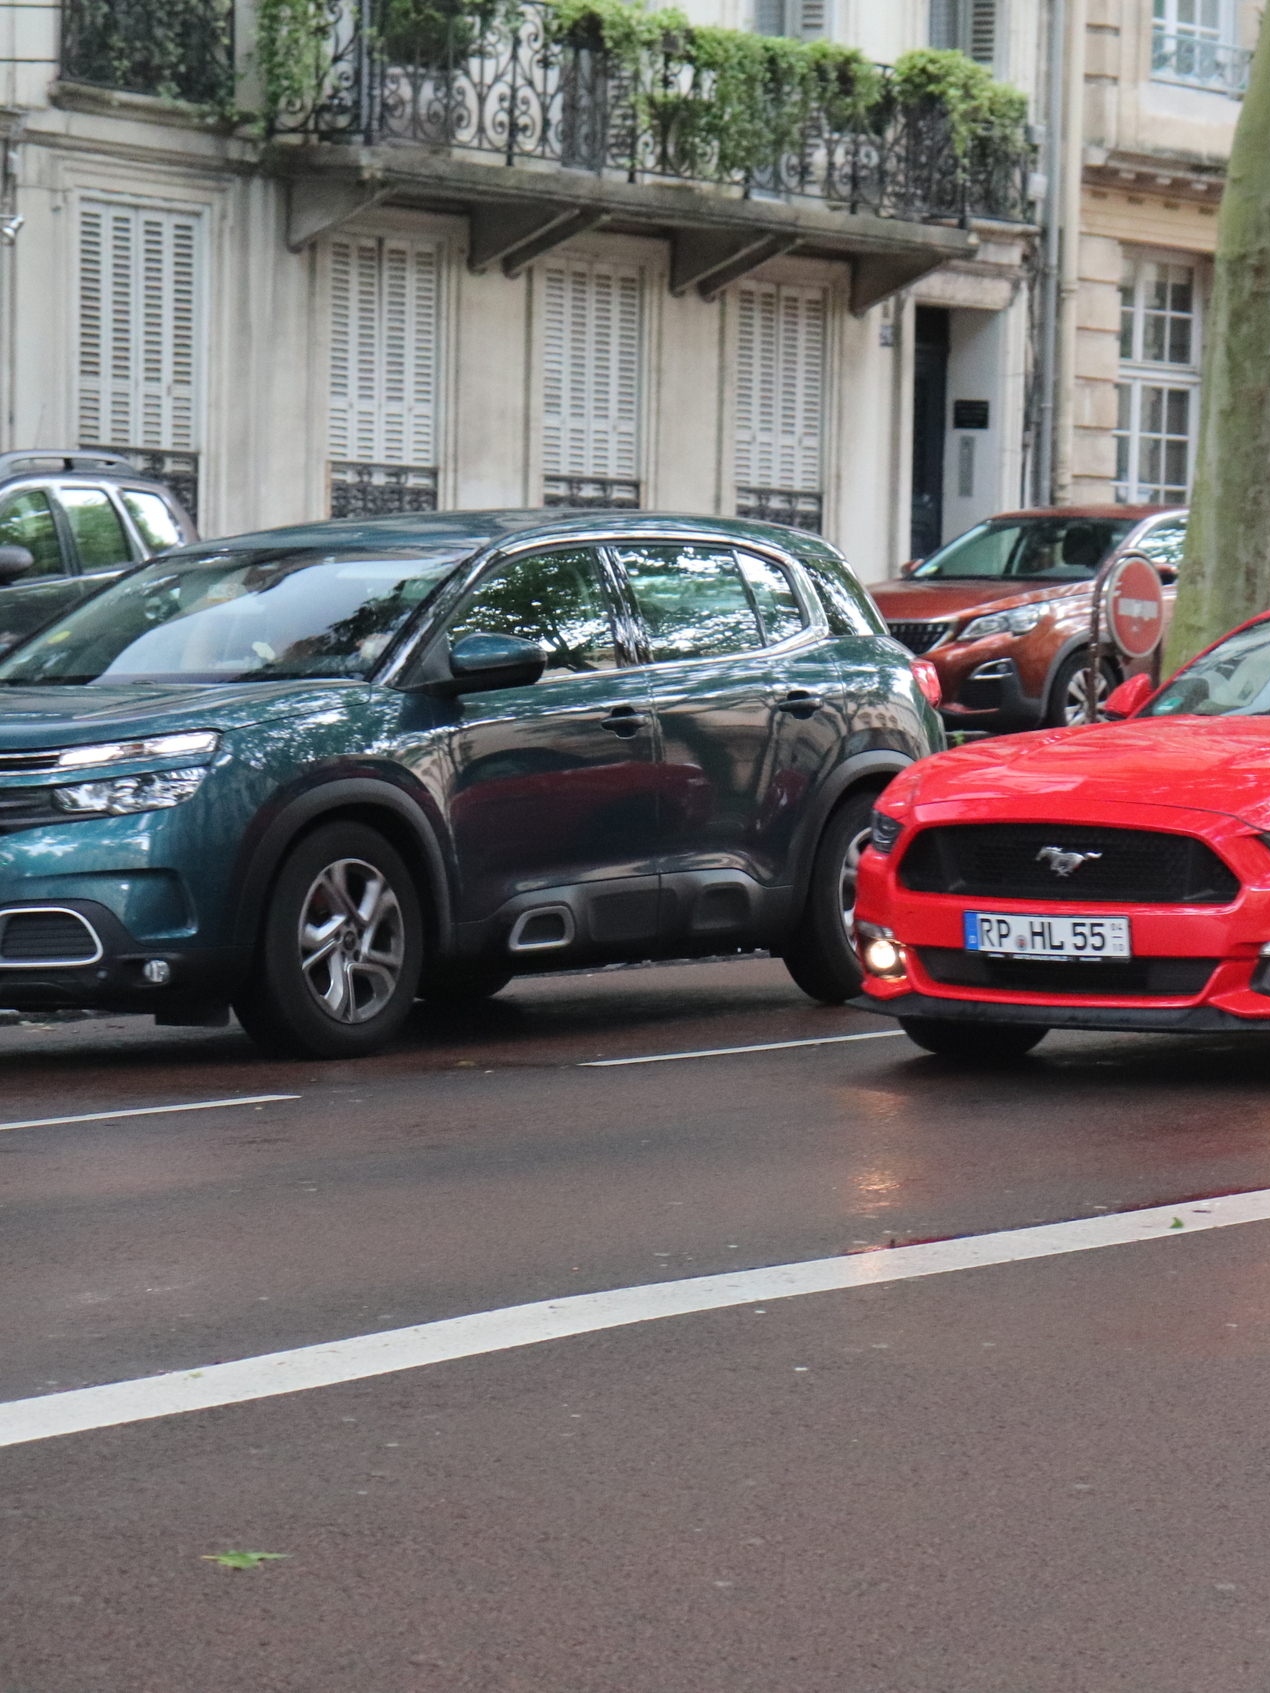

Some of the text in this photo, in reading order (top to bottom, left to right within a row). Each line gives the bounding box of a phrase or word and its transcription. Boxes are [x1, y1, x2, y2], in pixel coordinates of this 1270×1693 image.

[979, 917, 1106, 952] RP HL 55
